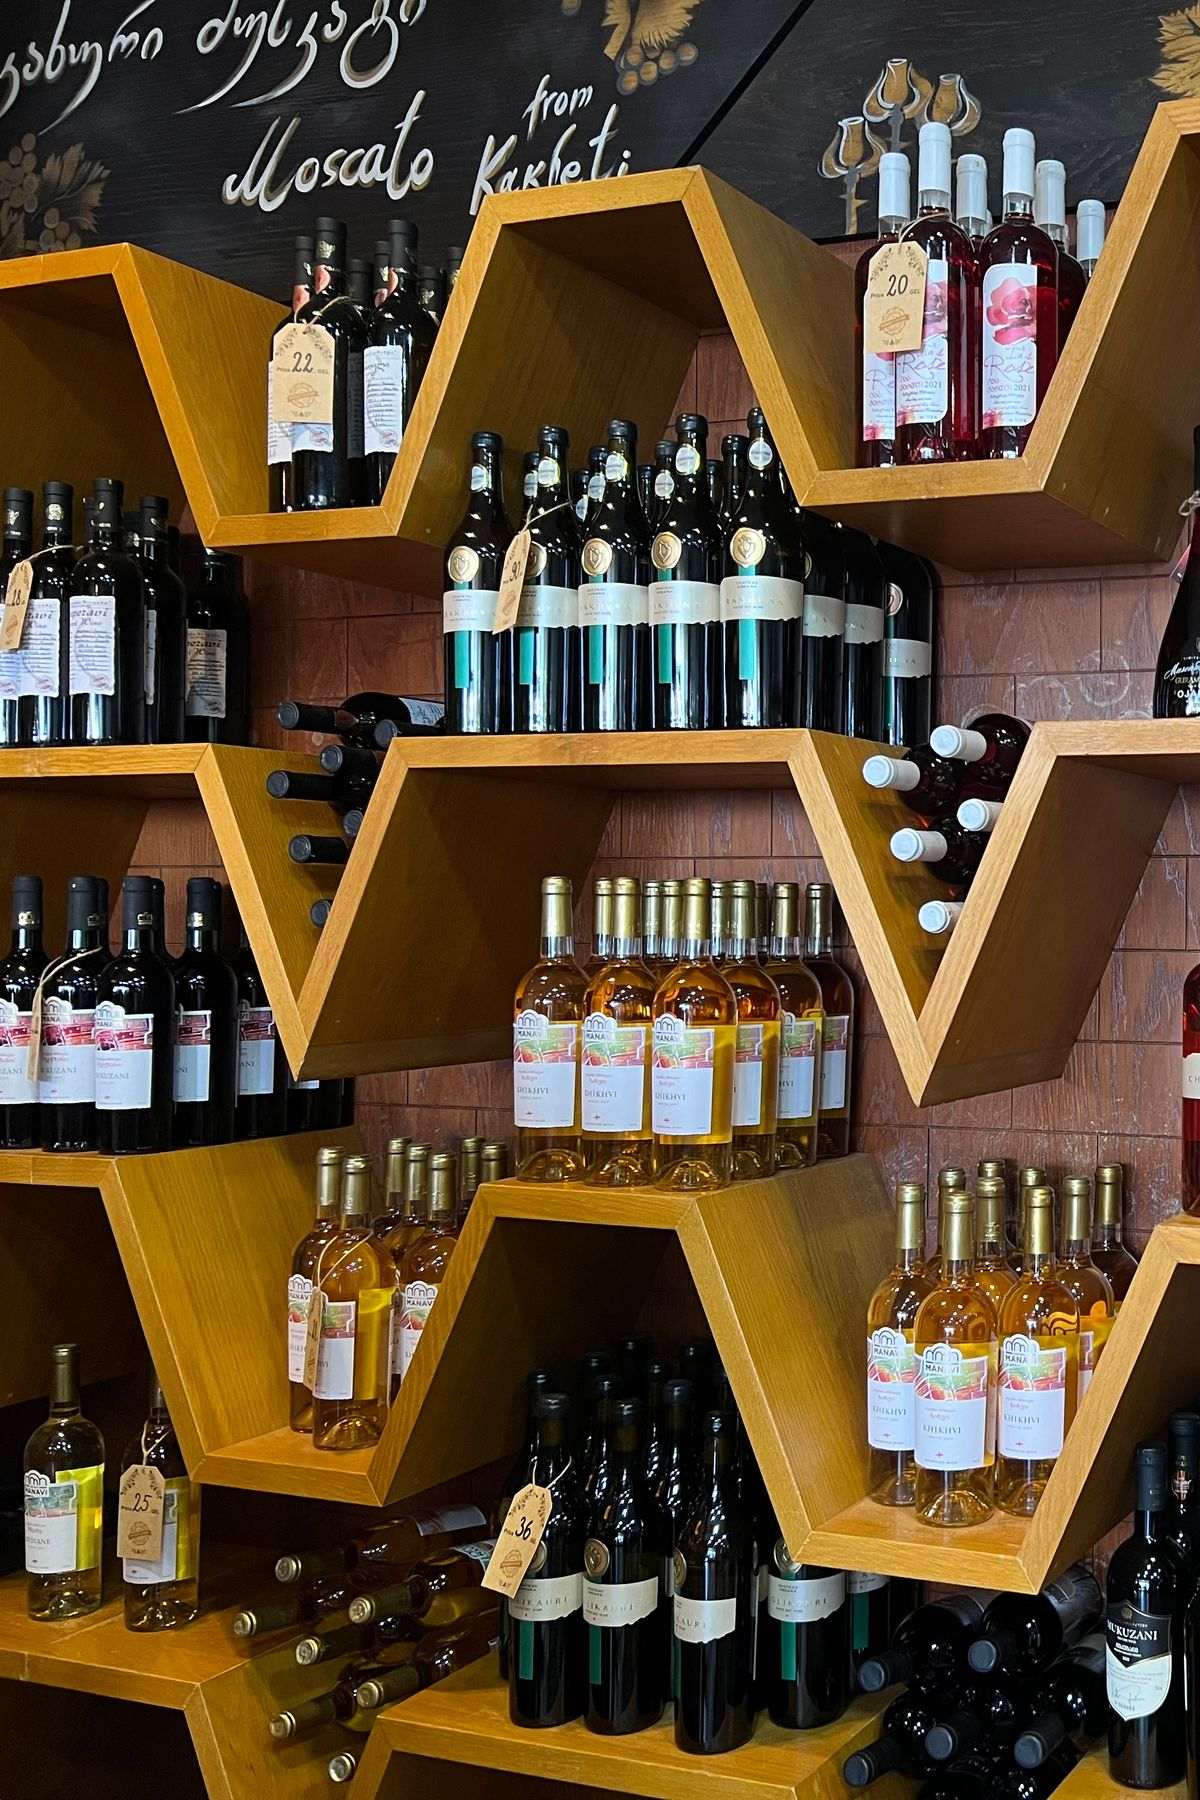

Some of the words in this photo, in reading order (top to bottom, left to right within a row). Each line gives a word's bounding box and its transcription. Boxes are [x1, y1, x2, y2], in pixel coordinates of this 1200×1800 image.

[522, 74, 593, 141] from
[224, 90, 434, 212] Moscato
[886, 274, 908, 297] 20
[292, 352, 314, 373] 22
[925, 1363, 960, 1374] MANVI
[133, 1493, 151, 1513] 25
[515, 1516, 534, 1540] 36
